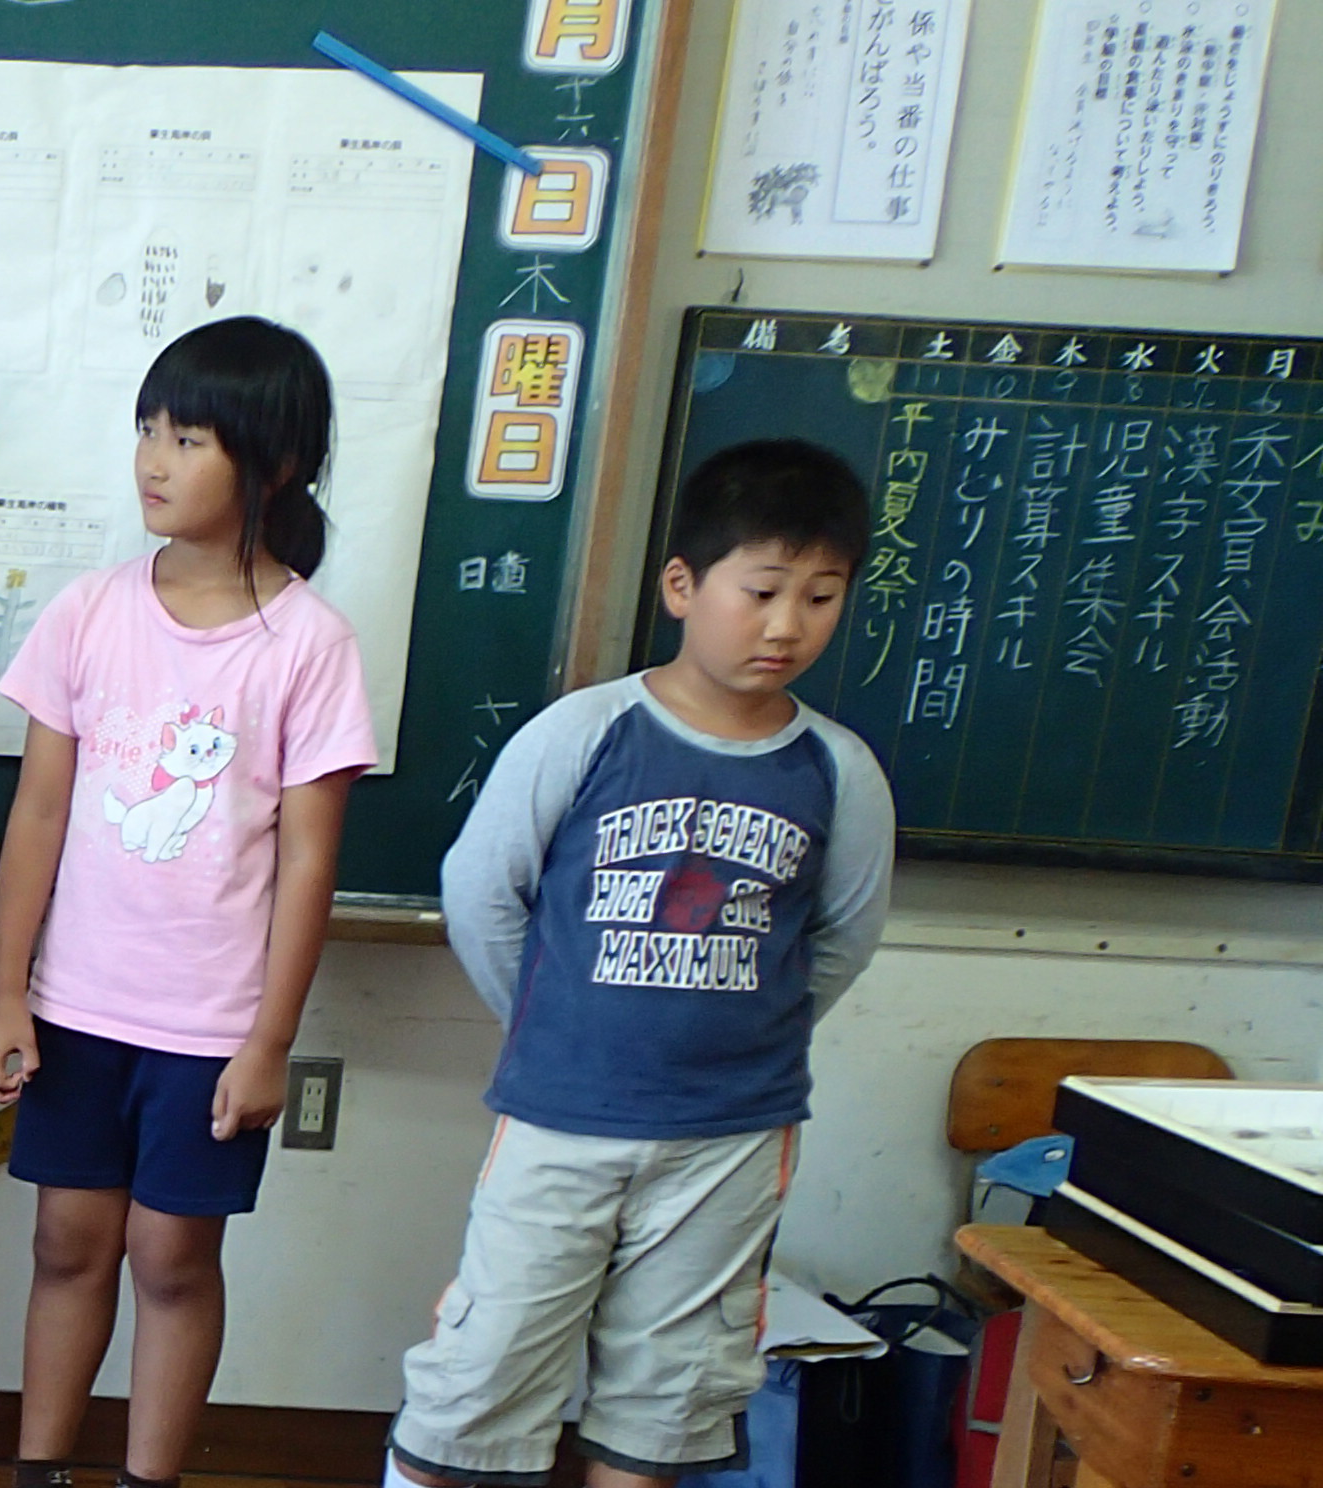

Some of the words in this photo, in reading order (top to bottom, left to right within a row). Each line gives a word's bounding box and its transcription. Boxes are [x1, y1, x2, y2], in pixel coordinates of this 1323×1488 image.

[858, 0, 895, 150] がんばろう。
[922, 331, 954, 359] 土
[985, 332, 1023, 363] 金
[1053, 335, 1088, 367] 木
[1121, 341, 1157, 371] 水
[1194, 344, 1224, 374] 火
[1264, 347, 1297, 379] 月
[860, 402, 934, 687] 平内夏祭り
[906, 416, 1010, 730] みどりの時間
[1062, 419, 1153, 688] 児童集会
[1134, 423, 1223, 673] 漢字スキル
[1173, 421, 1293, 750] 委員会活動
[584, 869, 666, 924] HIGH
[593, 797, 697, 868] TRICK
[591, 929, 759, 992] MAXIMUM
